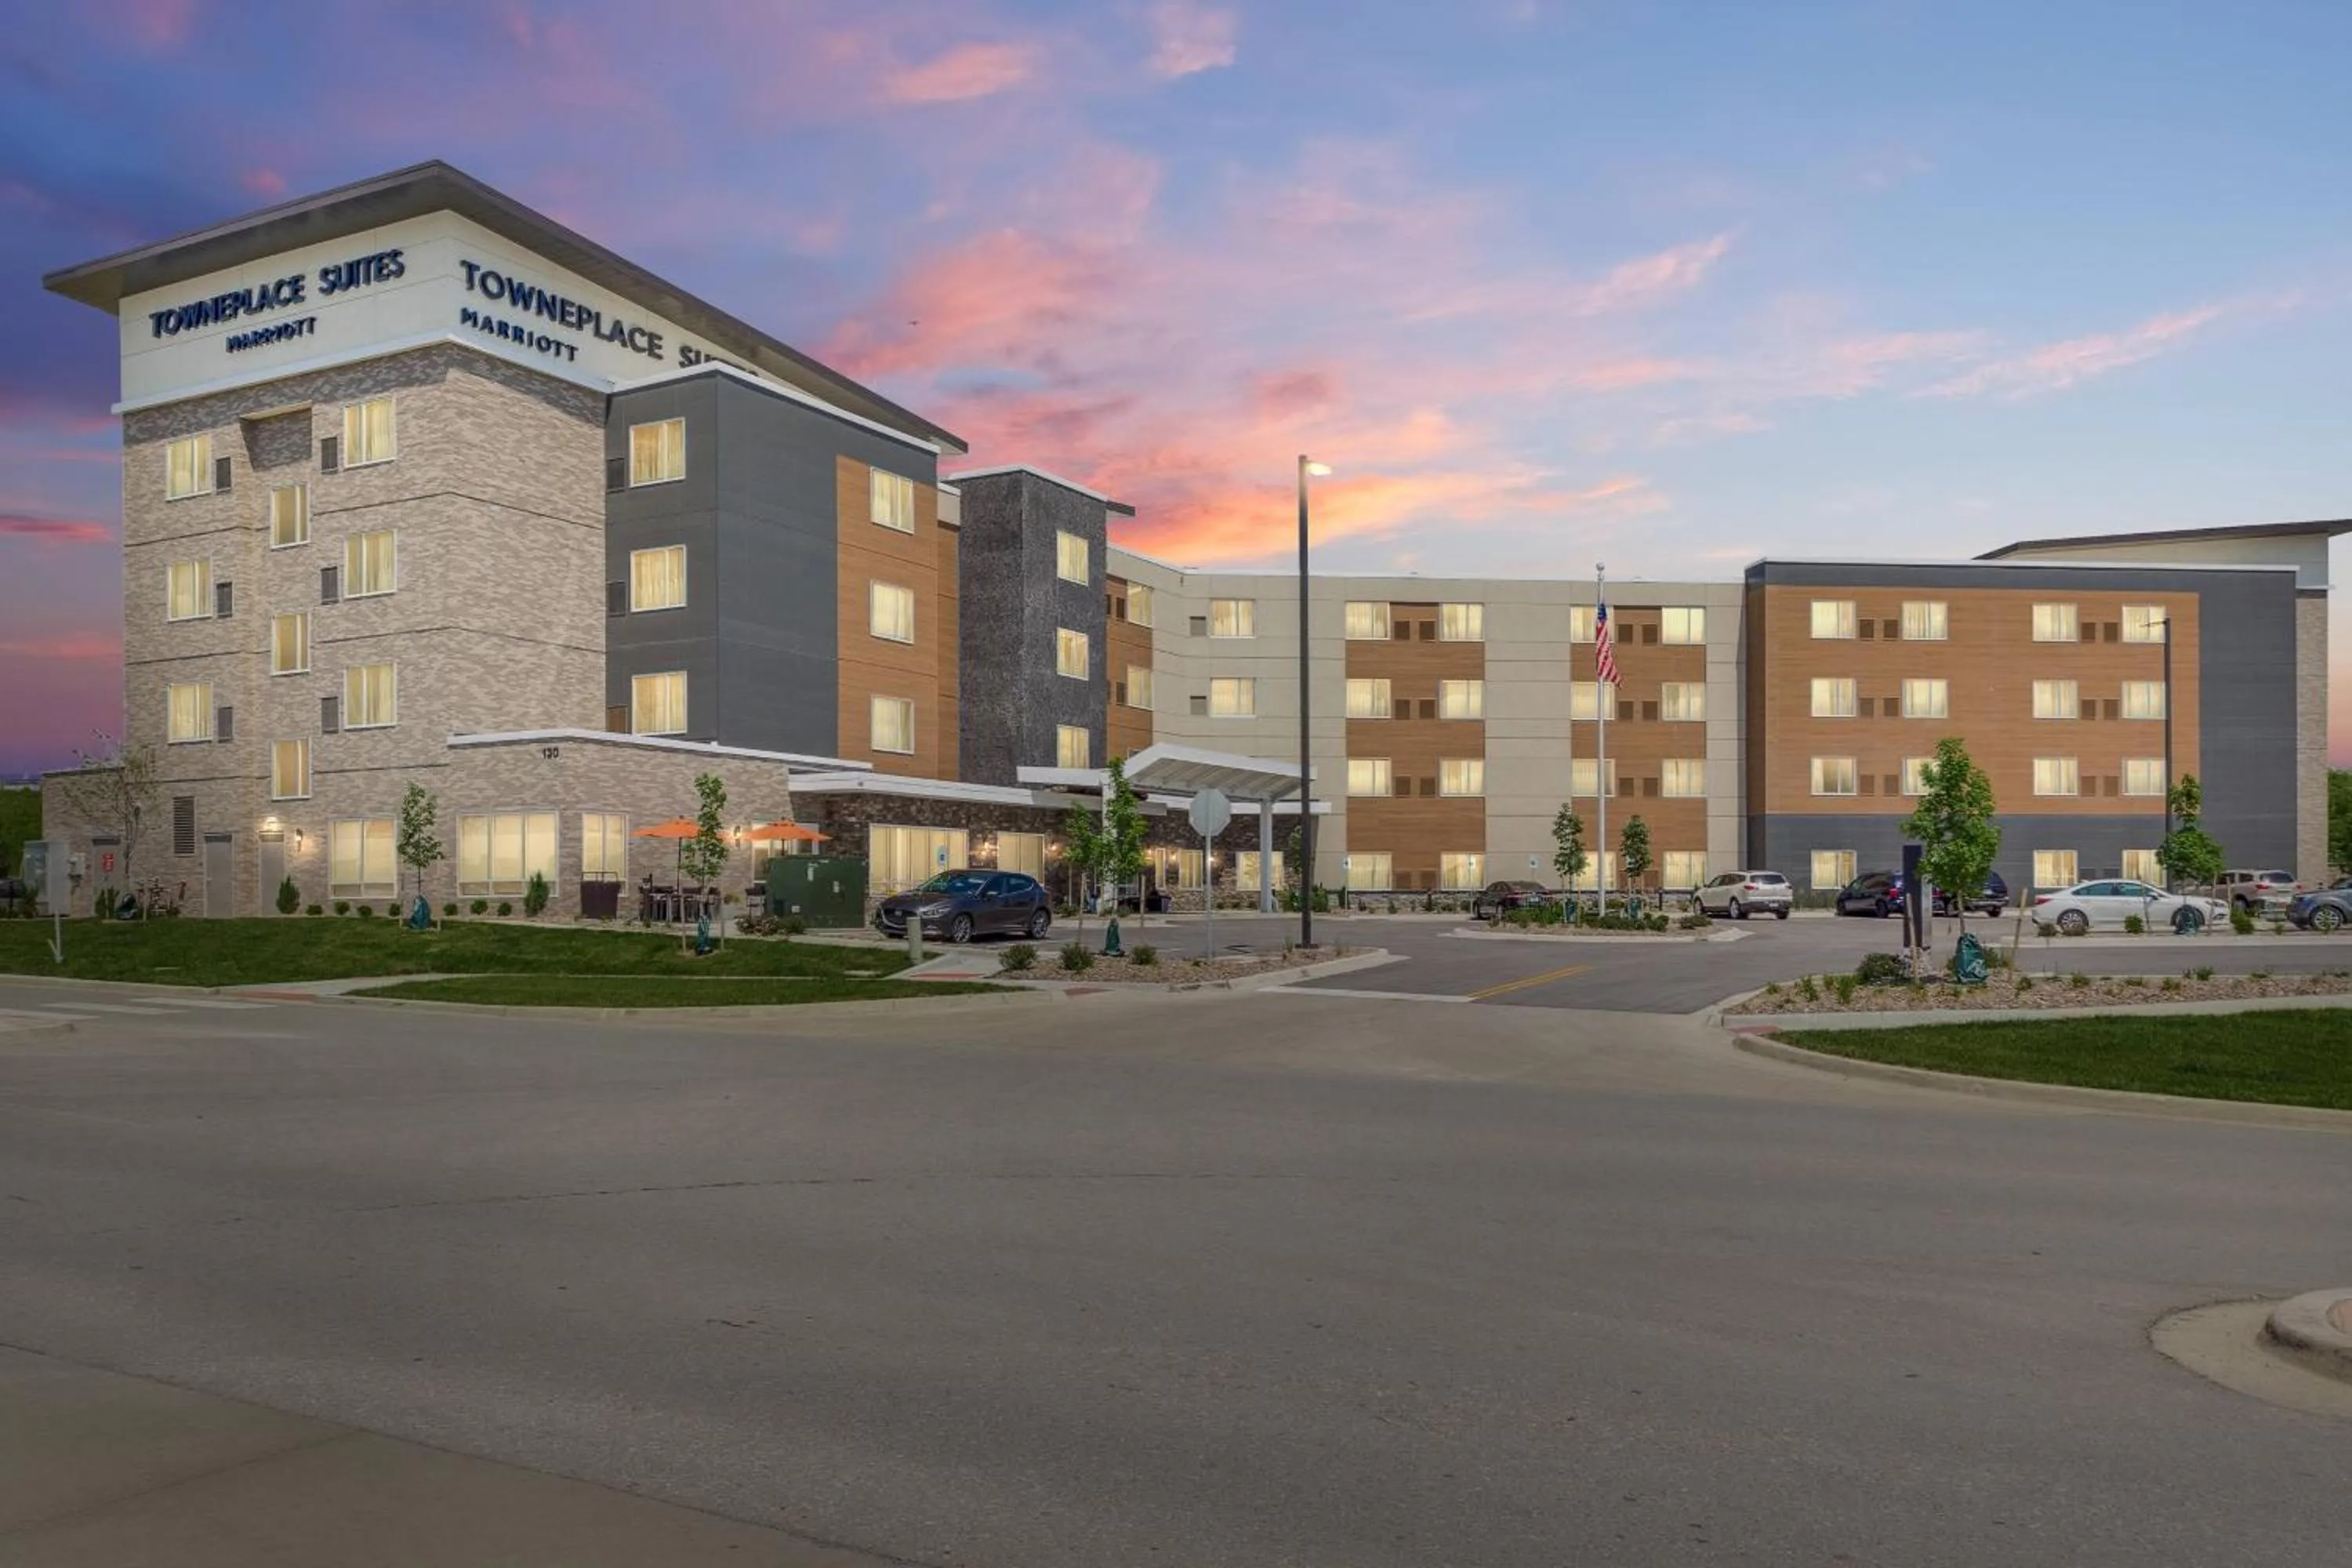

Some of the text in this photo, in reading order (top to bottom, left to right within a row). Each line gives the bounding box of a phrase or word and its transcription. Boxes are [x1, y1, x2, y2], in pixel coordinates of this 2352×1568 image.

[149, 249, 405, 339] TOWNEPLACE SUITES
[459, 260, 664, 360] TOWNEPLACE
[226, 317, 317, 354] MARRIOTT
[459, 307, 579, 362] MARRIOTT
